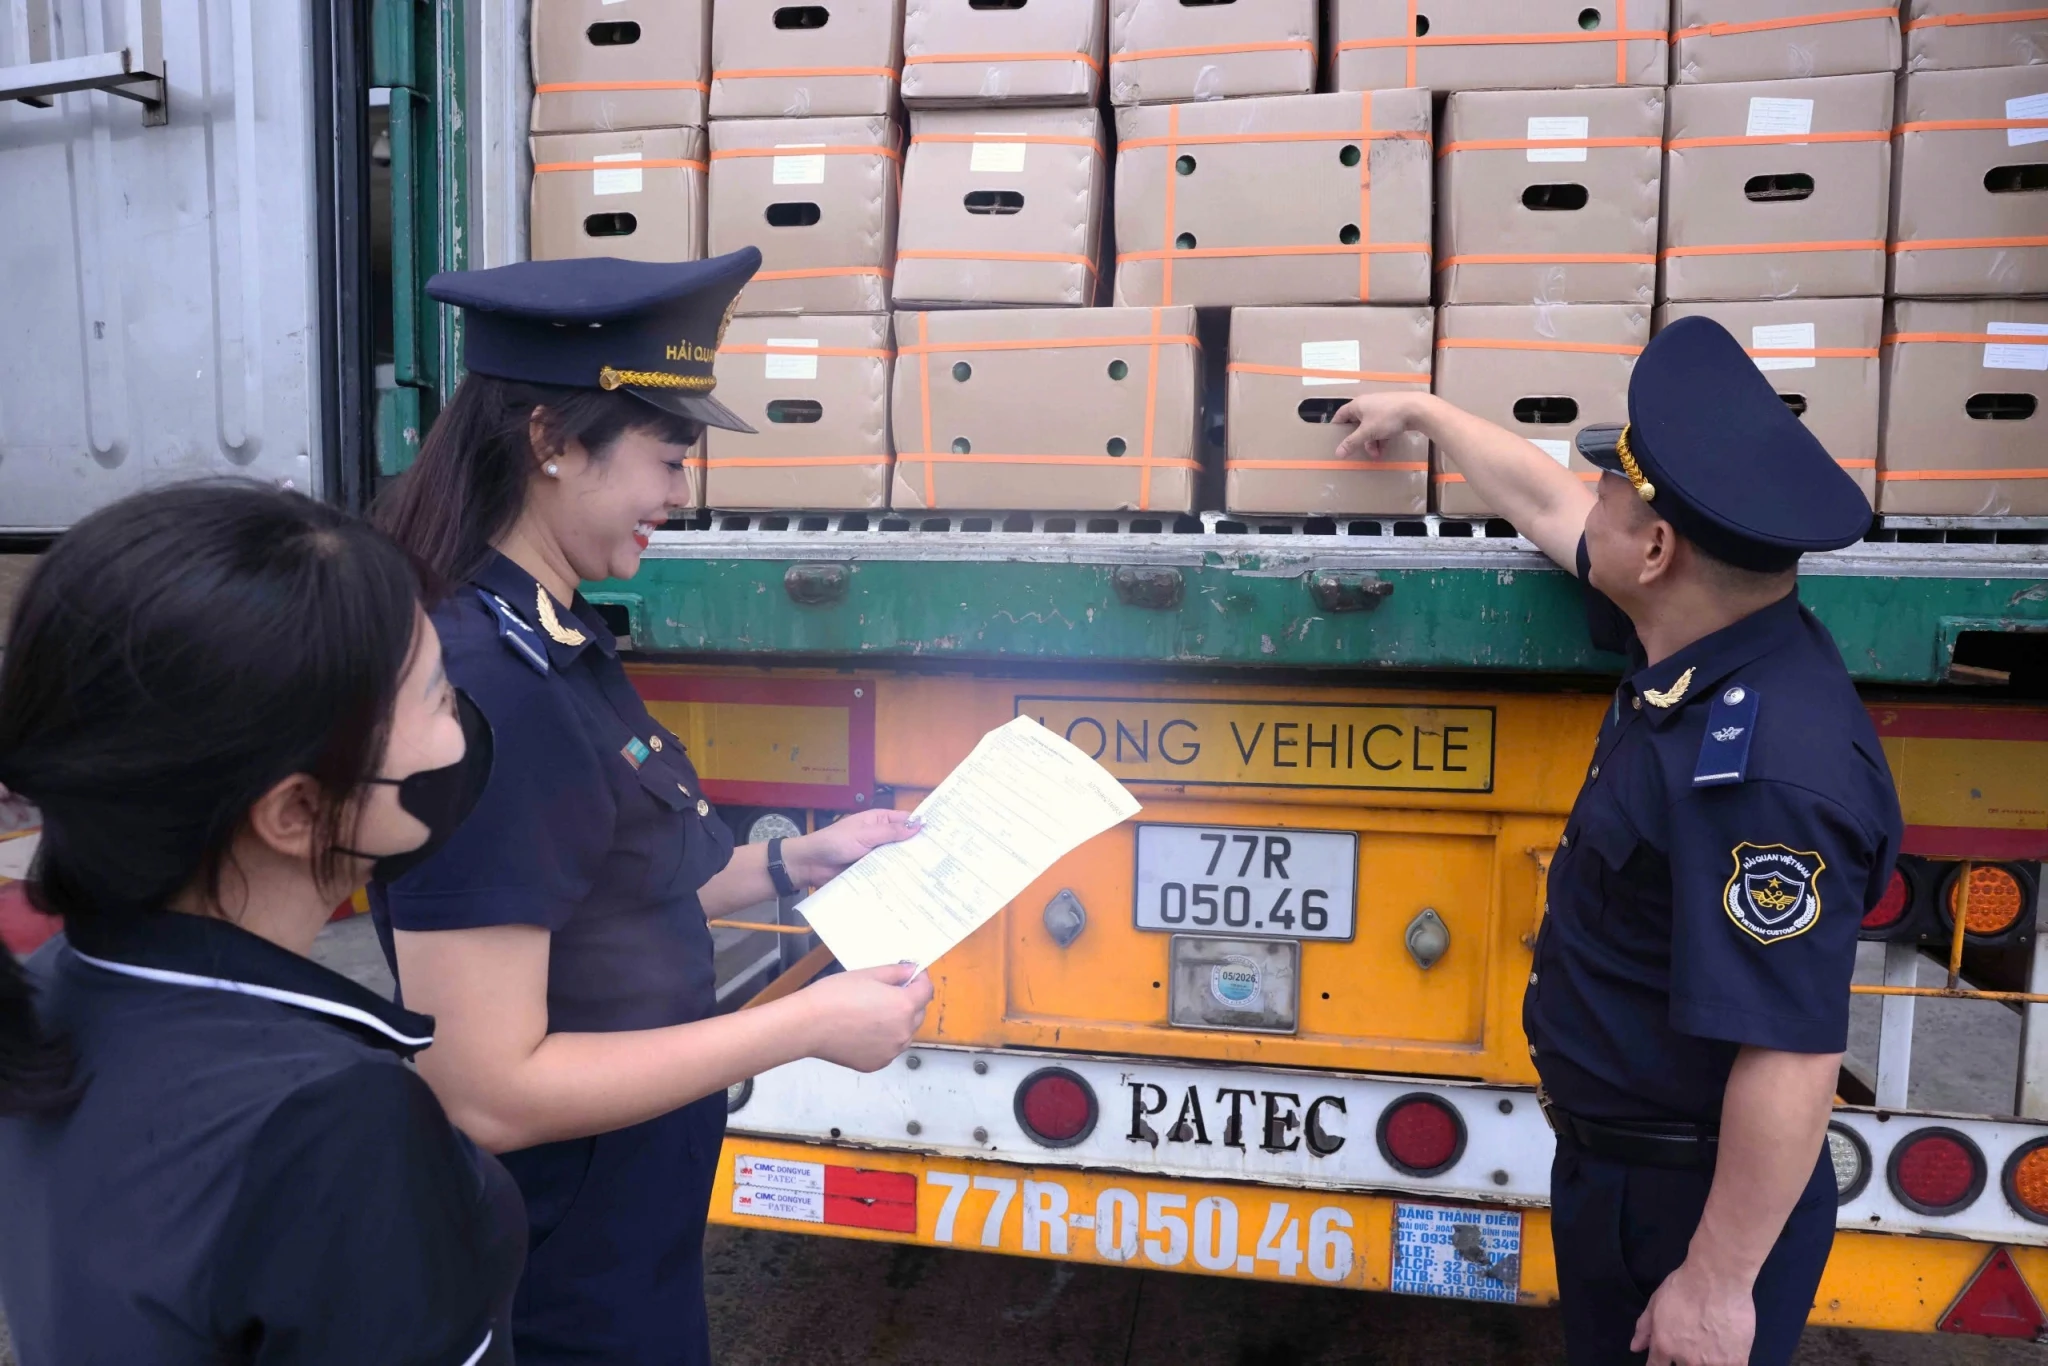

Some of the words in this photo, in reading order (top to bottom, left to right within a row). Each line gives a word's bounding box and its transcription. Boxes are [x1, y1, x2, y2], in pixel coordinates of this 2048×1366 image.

[694, 346, 716, 363] QUA
[1039, 716, 1201, 766] ONG
[1229, 720, 1470, 772] VEHICLE
[1199, 833, 1292, 880] 77R
[1755, 853, 1779, 863] QUAN
[1794, 861, 1811, 879] NAM
[1160, 882, 1329, 931] 050.46
[1222, 971, 1256, 983] 05/2026
[1125, 1082, 1348, 1155] PATEC
[754, 1163, 776, 1172] CIMC
[776, 1165, 811, 1176] DONGYUE
[767, 1174, 797, 1184] PATEC
[739, 1196, 752, 1204] 3M
[755, 1192, 776, 1201] CIMC
[777, 1194, 811, 1205] DONGYUE
[768, 1202, 798, 1213] PATEC
[926, 1170, 1354, 1281] 77R-050.46
[1393, 1268, 1433, 1283] KLTB:
